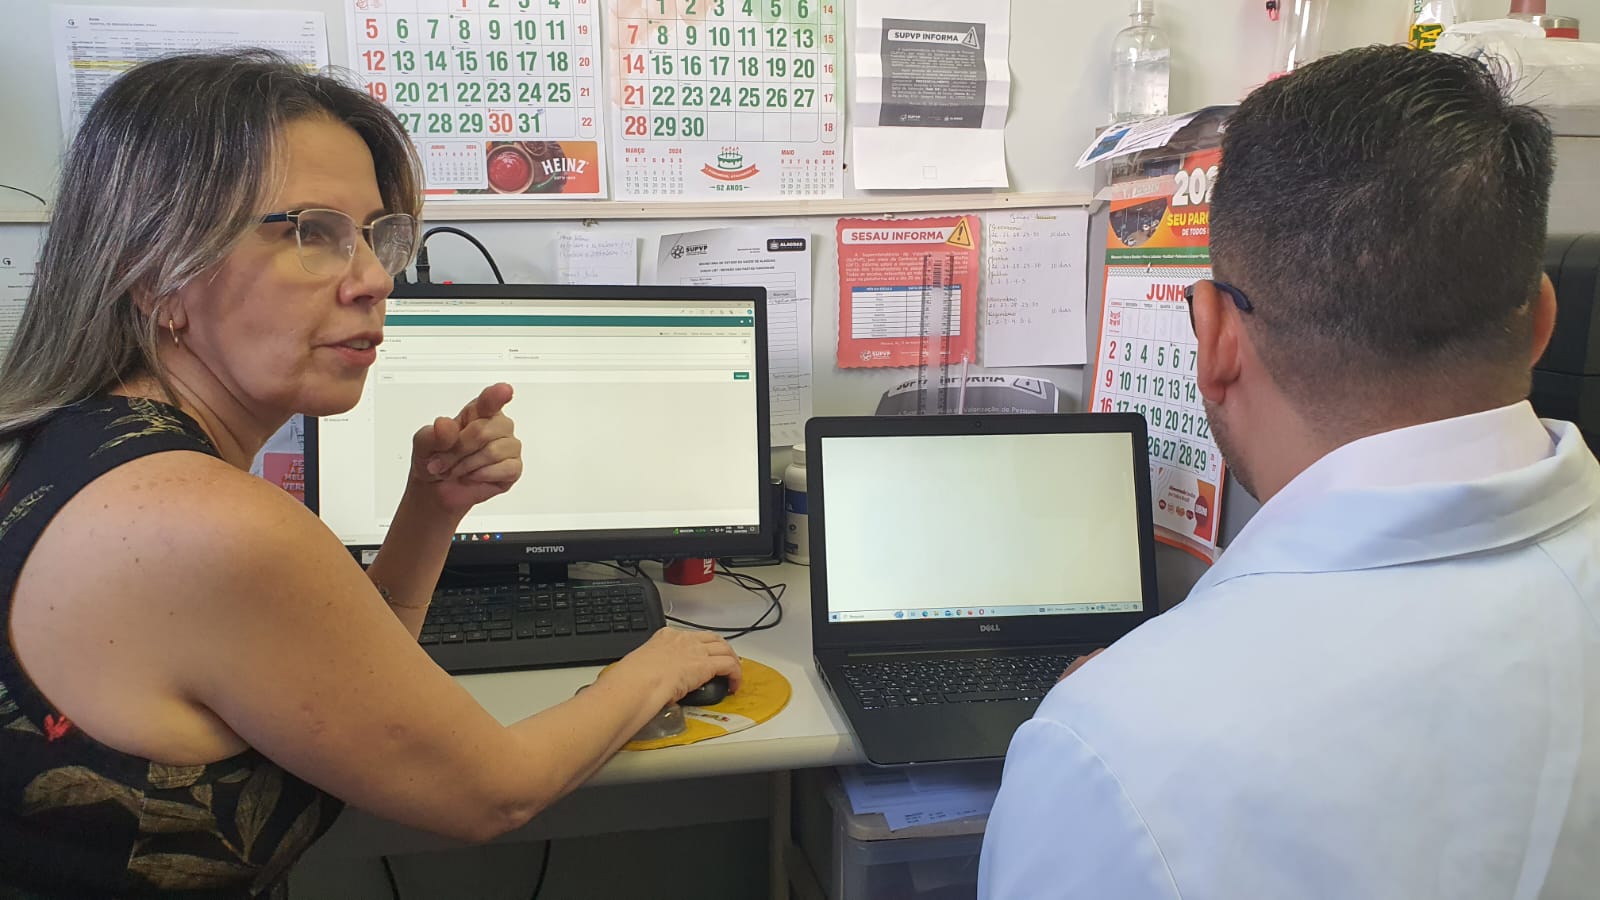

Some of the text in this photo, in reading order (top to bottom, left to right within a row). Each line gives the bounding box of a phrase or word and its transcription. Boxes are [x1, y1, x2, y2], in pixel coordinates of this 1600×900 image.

[658, 0, 666, 15] 1
[685, 0, 696, 15] 2
[714, 0, 724, 16] 3
[742, 0, 752, 16] 4
[771, 0, 781, 17] 5
[798, 0, 808, 18] 6
[366, 19, 378, 39] 5
[397, 19, 408, 39] 6
[427, 19, 439, 39] 7
[459, 20, 470, 40] 8
[489, 20, 500, 40] 9
[514, 20, 536, 40] 10
[546, 20, 565, 40] 11
[627, 25, 639, 44] 7
[658, 26, 668, 45] 8
[686, 26, 696, 45] 9
[709, 27, 730, 46] 10
[738, 27, 756, 46] 11
[766, 28, 787, 47] 12
[793, 29, 813, 48] 13
[923, 33, 958, 42] INFORMA
[363, 50, 385, 70] 12
[392, 51, 415, 71] 13
[424, 51, 447, 71] 14
[456, 51, 477, 71] 15
[486, 51, 508, 71] 16
[517, 52, 537, 71] 17
[547, 52, 568, 72] 18
[623, 54, 644, 74] 14
[652, 55, 673, 75] 15
[681, 56, 701, 76] 16
[709, 56, 729, 76] 17
[738, 57, 758, 76] 18
[766, 58, 786, 77] 19
[794, 59, 815, 78] 20
[365, 82, 387, 103] 19
[395, 82, 419, 103] 20
[427, 82, 448, 103] 21
[457, 83, 481, 103] 22
[487, 83, 511, 102] 23
[518, 83, 541, 102] 24
[547, 83, 571, 103] 25
[624, 86, 644, 105] 21
[652, 86, 675, 106] 22
[682, 86, 703, 106] 23
[710, 87, 732, 106] 24
[739, 88, 760, 107] 25
[766, 88, 787, 107] 26
[794, 89, 815, 108] 27
[429, 113, 452, 133] 28
[459, 114, 483, 133] 29
[489, 114, 513, 133] 30
[519, 114, 540, 133] 31
[625, 116, 647, 135] 28
[654, 117, 676, 136] 29
[682, 117, 704, 137] 30
[541, 157, 586, 175] HEINZ
[1172, 165, 1218, 206] 202
[1167, 213, 1187, 227] SEU
[851, 231, 944, 241] SESAU INFORMA
[1190, 228, 1207, 236] TODOS
[1146, 283, 1185, 302] JUNH
[1109, 341, 1196, 370] 2 3 4 5 6 7
[1106, 370, 1196, 402] 9 10 11 12 13 14
[1101, 398, 1112, 412] 16
[1117, 401, 1129, 412] 17
[1150, 407, 1161, 426] 19
[1165, 410, 1178, 431] 20
[1182, 413, 1194, 434] 21
[1197, 417, 1209, 439] 22
[1149, 436, 1206, 471] 26 27 28 29
[980, 624, 1000, 632] DELL
